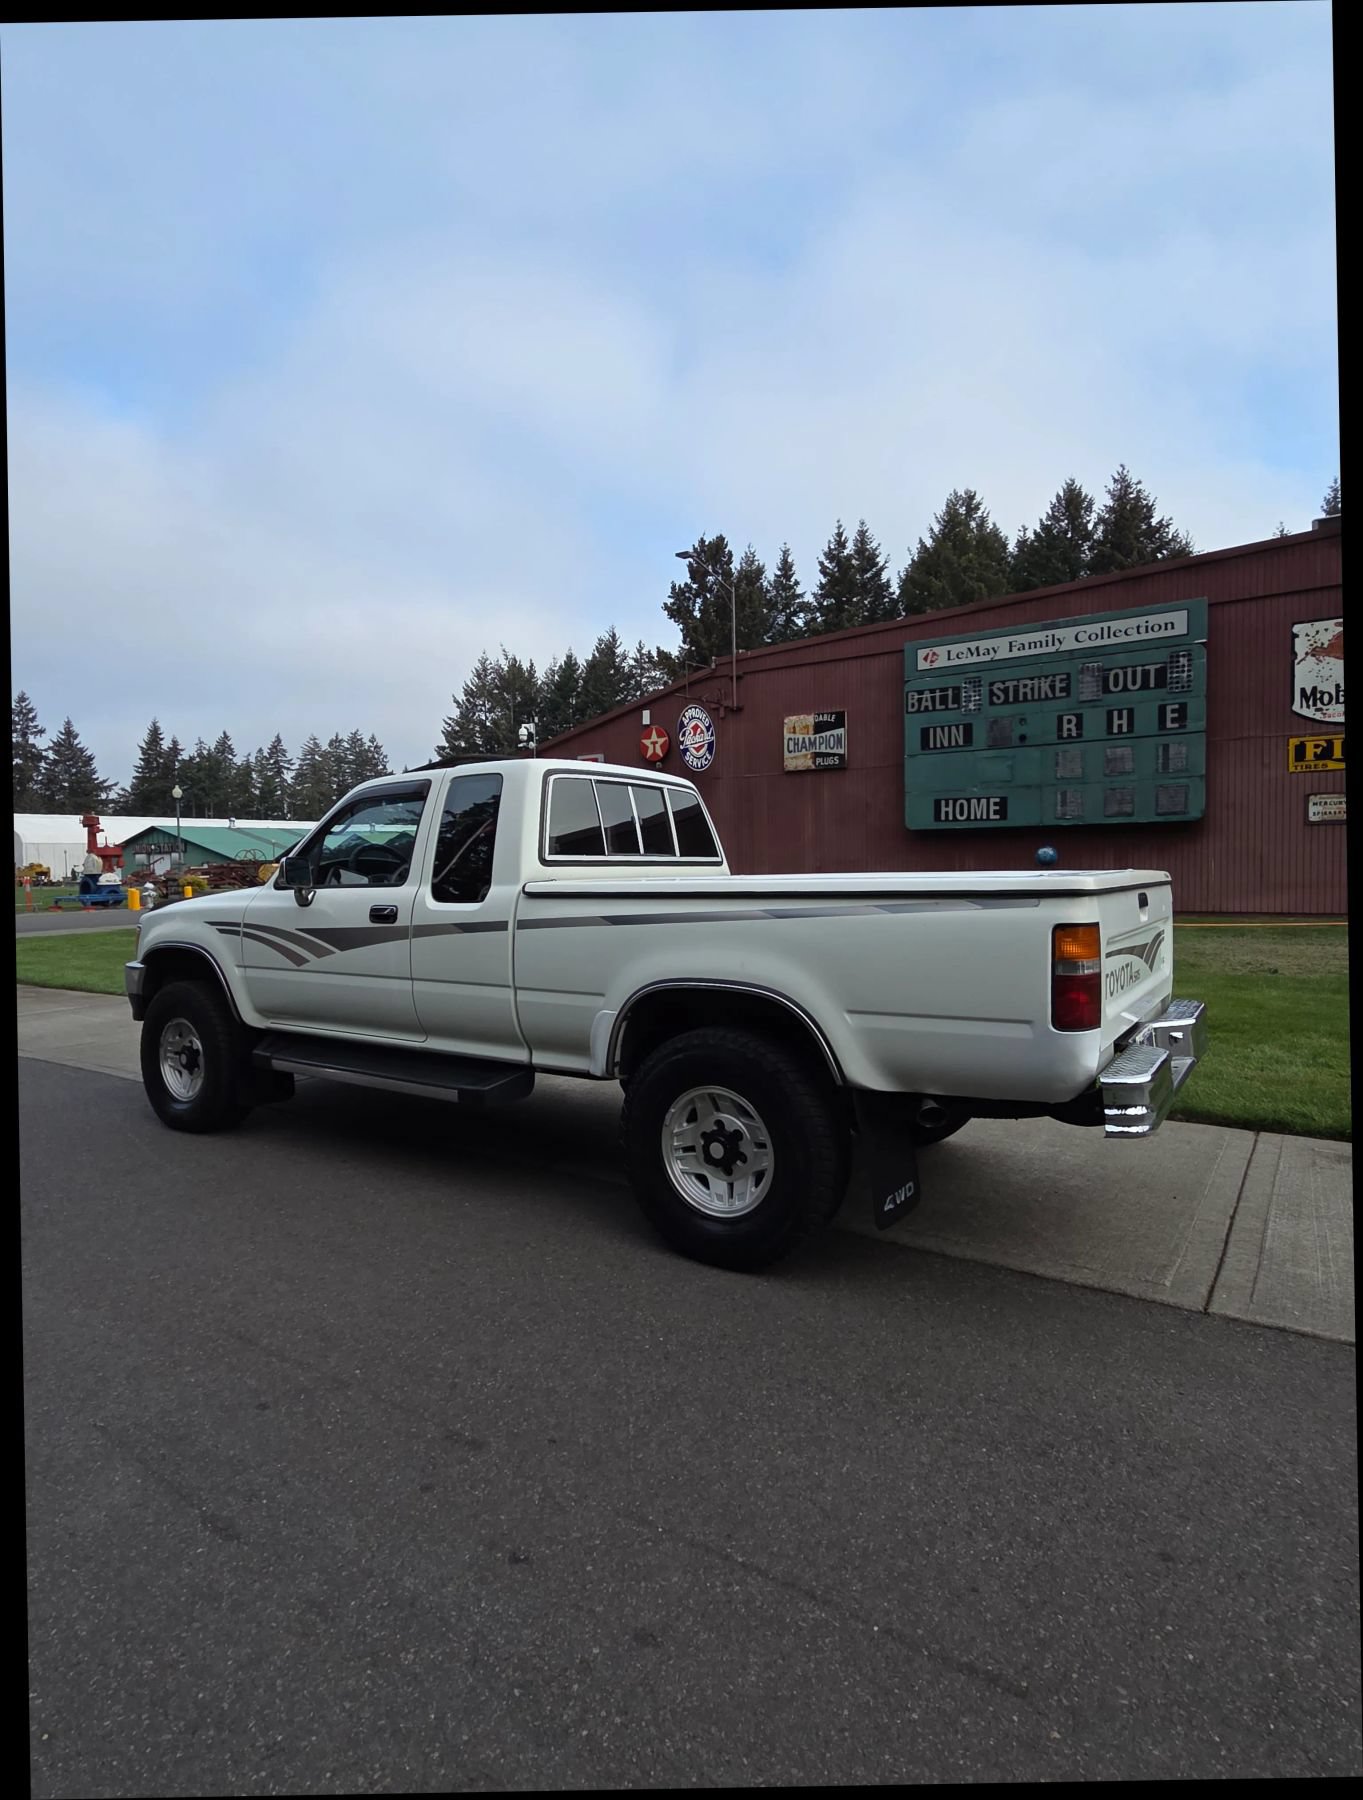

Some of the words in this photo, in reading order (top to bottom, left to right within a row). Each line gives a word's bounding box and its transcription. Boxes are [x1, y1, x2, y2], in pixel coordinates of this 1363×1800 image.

[947, 644, 1000, 661] LeMay
[1008, 634, 1066, 652] Family
[1074, 620, 1175, 644] Collection
[908, 688, 958, 712] BALL
[993, 675, 1067, 703] STRIKE
[1109, 664, 1163, 692] OUT
[682, 707, 709, 726] APPROVED
[929, 725, 964, 749] INN
[1063, 715, 1077, 738] R
[1113, 709, 1128, 734] H
[1166, 704, 1179, 728] E
[679, 727, 714, 749] Packard
[787, 733, 843, 753] CHAMPION
[684, 751, 711, 768] SERVICE
[815, 756, 840, 766] PLUGS
[941, 798, 1000, 820] HOME
[1105, 961, 1133, 1000] TOYOTA
